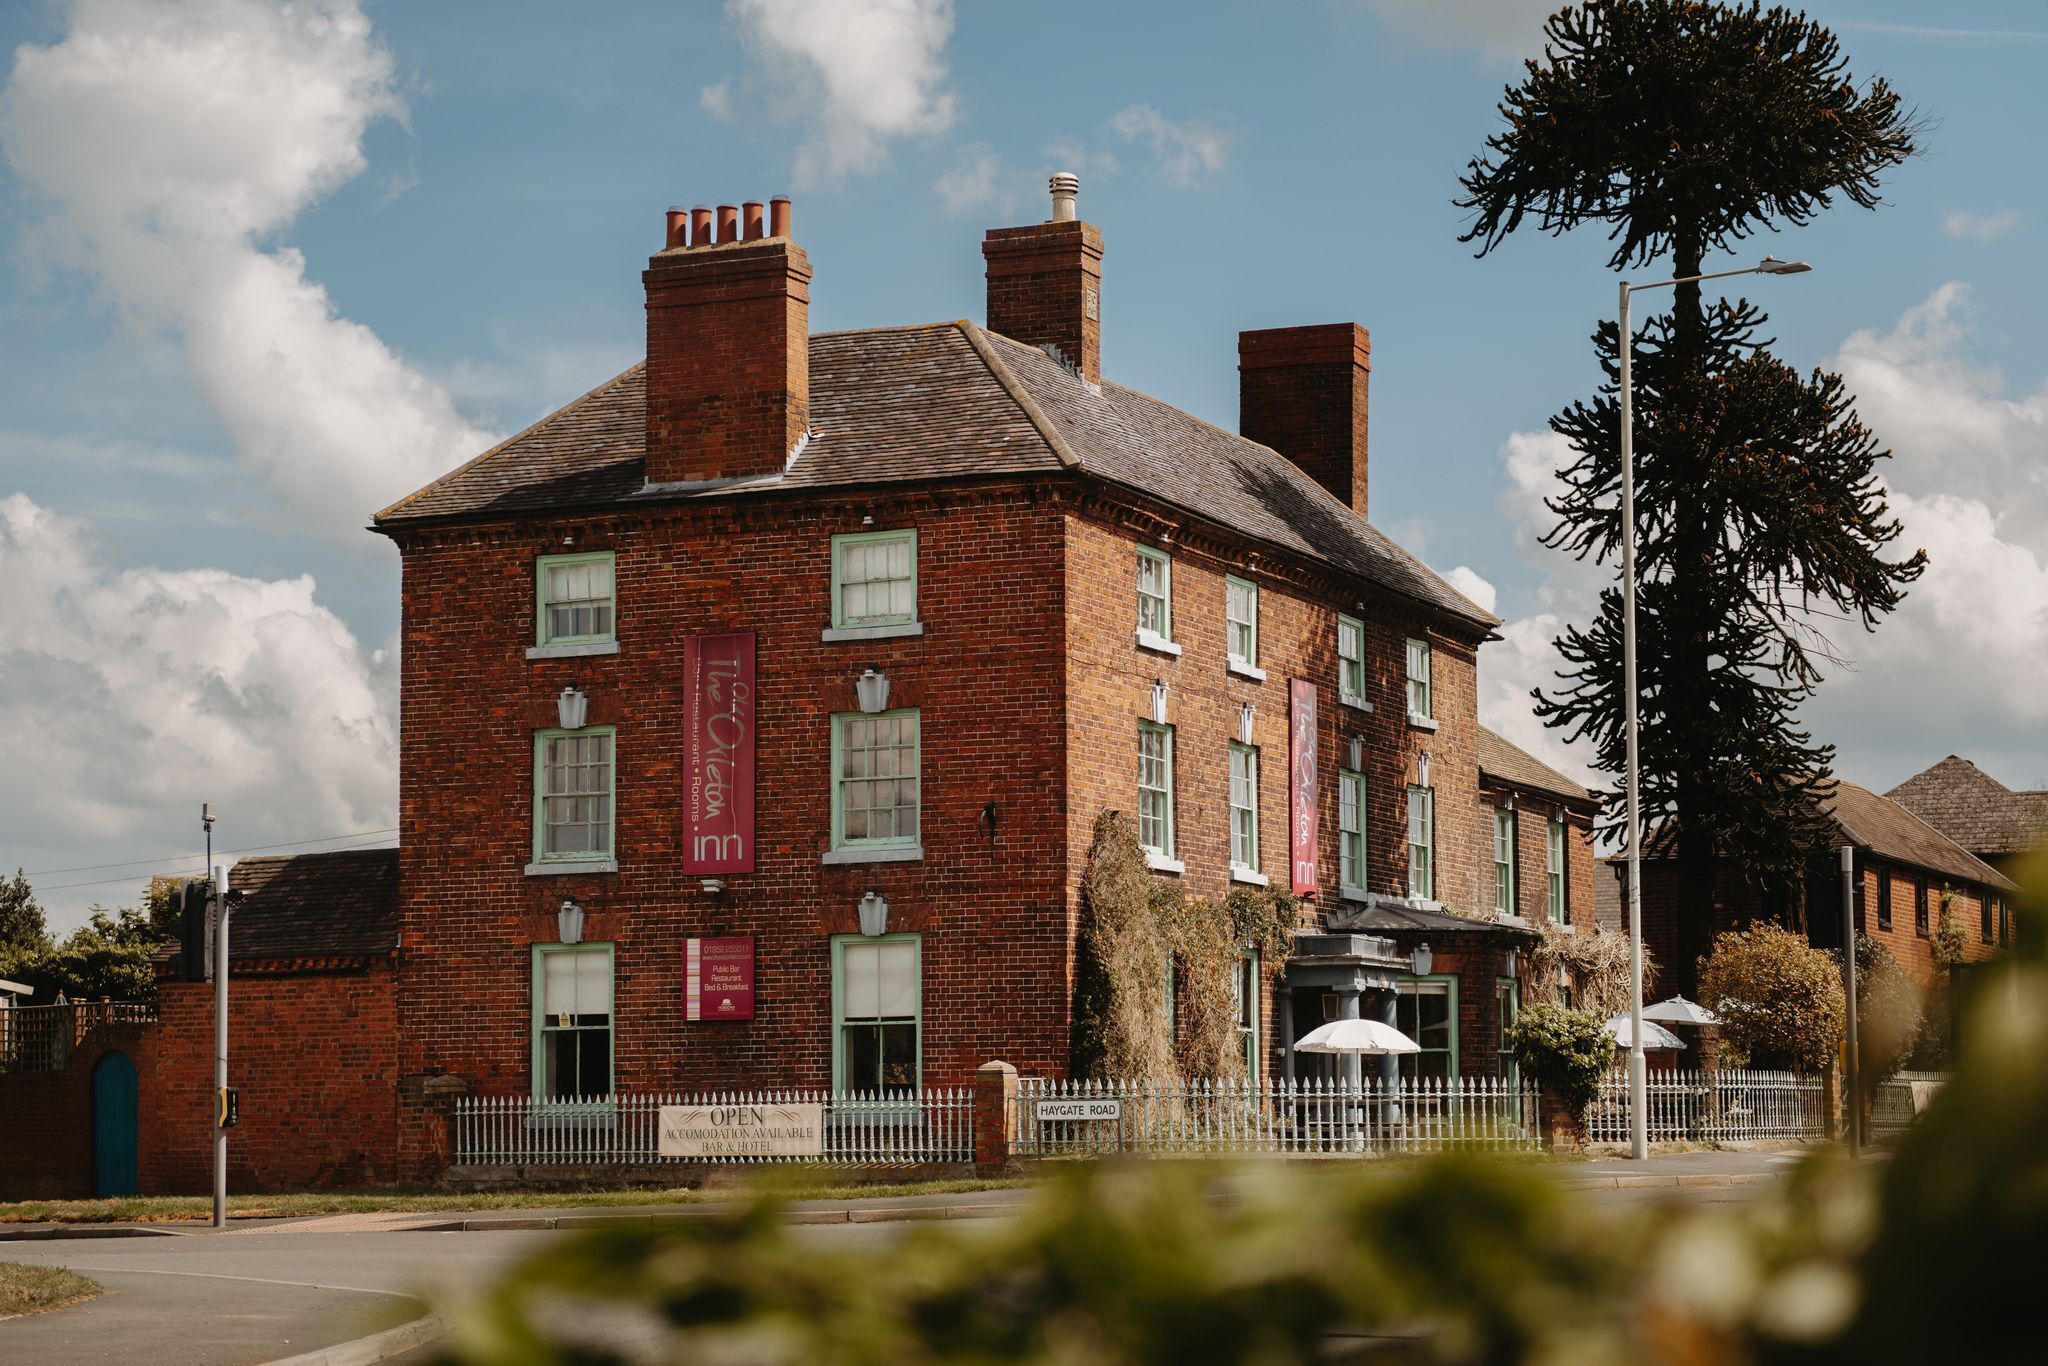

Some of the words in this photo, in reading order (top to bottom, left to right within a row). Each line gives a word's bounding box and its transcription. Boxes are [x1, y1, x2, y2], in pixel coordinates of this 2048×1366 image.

[703, 651, 740, 706] The
[691, 692, 701, 765] Restaurant
[1300, 697, 1312, 743] The
[704, 713, 745, 820] Orleton
[691, 776, 701, 822] Rooms
[1300, 752, 1314, 848] Orleton
[711, 974, 742, 982] Restaurant
[712, 965, 729, 973] Public
[730, 965, 741, 973] Bar
[704, 983, 716, 991] Bed
[716, 983, 721, 991] &
[722, 982, 749, 991] Breakfast
[710, 1107, 765, 1127] OPEN
[1040, 1105, 1084, 1116] HAYGATE
[1090, 1104, 1116, 1115] ROAD
[664, 1129, 750, 1140] ACCOMODATION
[753, 1127, 813, 1139] AVAILABLE
[702, 1141, 723, 1152] BAR
[725, 1142, 734, 1152] &
[737, 1140, 774, 1152] HOTEL
